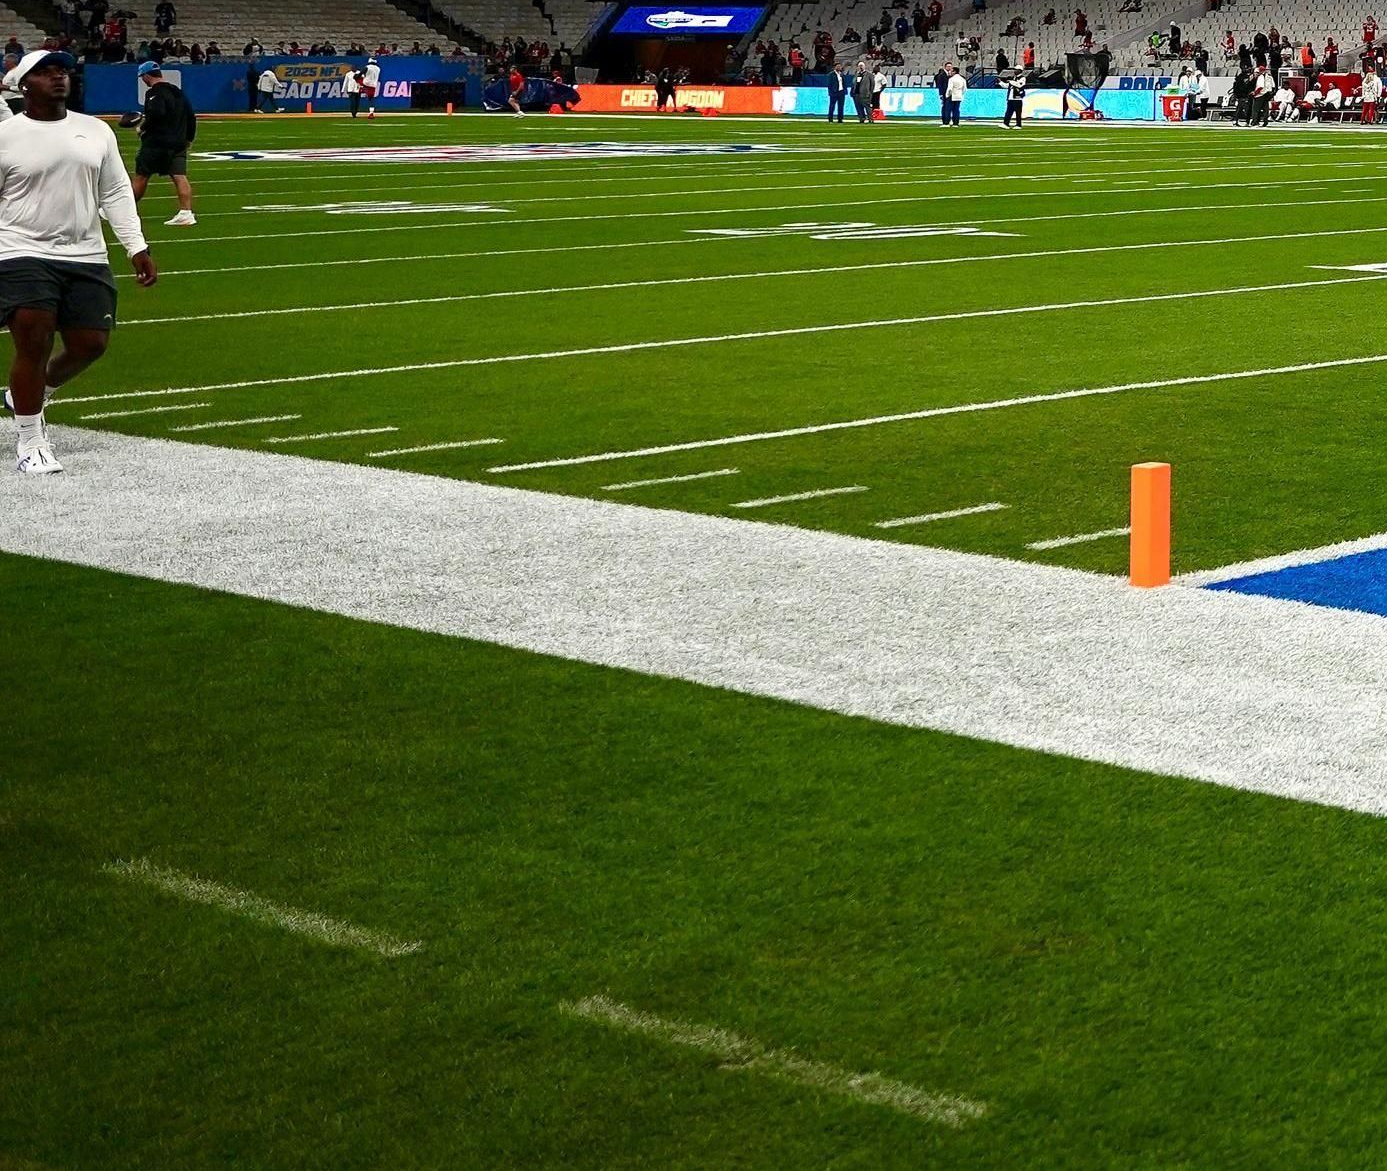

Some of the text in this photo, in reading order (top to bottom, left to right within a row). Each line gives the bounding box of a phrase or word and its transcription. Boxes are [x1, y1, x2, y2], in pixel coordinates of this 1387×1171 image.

[284, 65, 342, 77] 2025 NFL
[383, 81, 411, 98] GA
[621, 89, 658, 107] CHIEF
[1169, 99, 1181, 111] G
